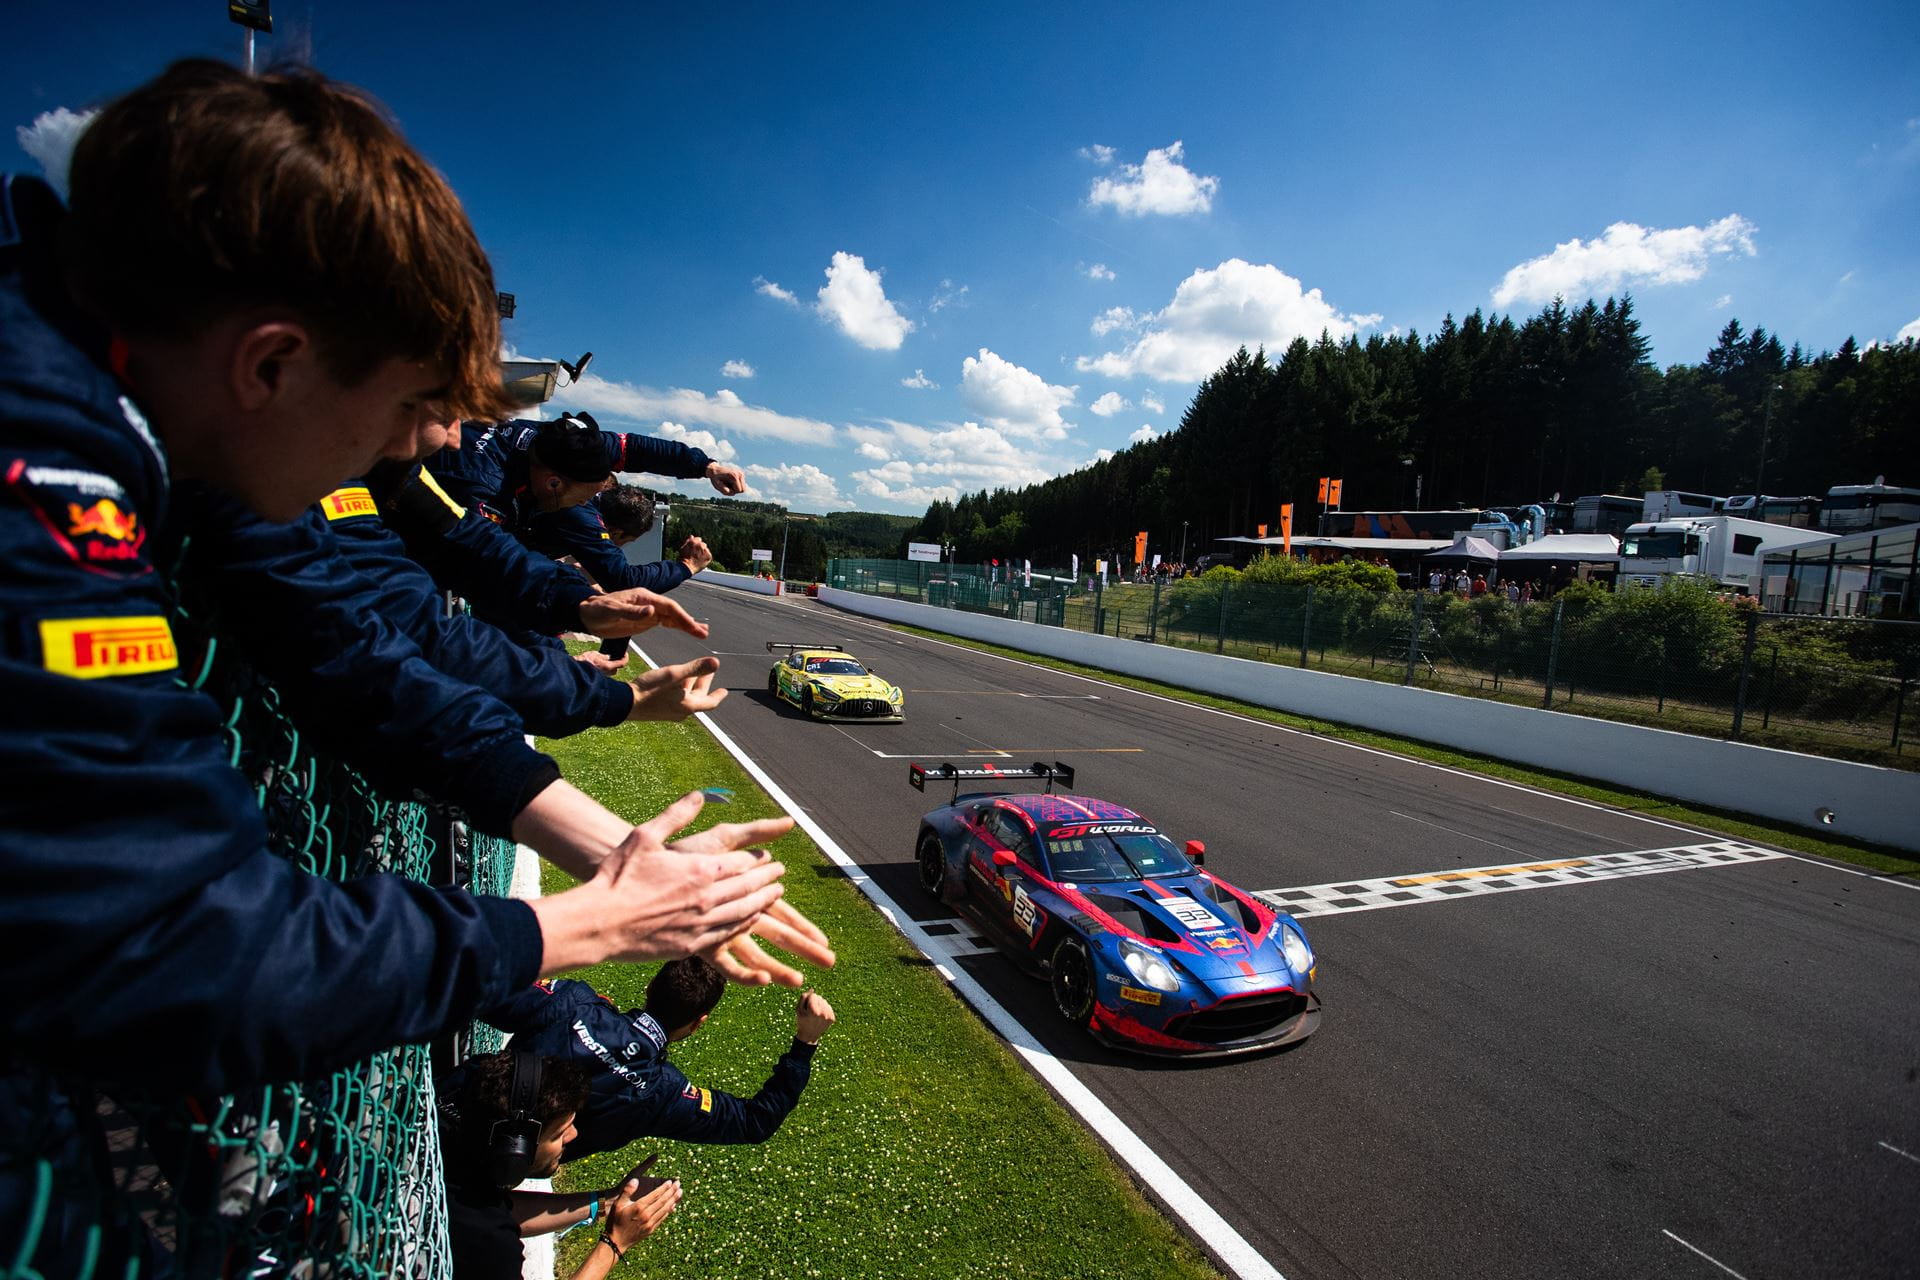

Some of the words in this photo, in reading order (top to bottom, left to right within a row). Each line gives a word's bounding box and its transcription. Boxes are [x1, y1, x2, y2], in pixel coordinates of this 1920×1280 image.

[1048, 823, 1100, 839] GT
[1089, 825, 1157, 834] WORLD
[1014, 897, 1036, 927] 33
[1176, 909, 1212, 922] 33
